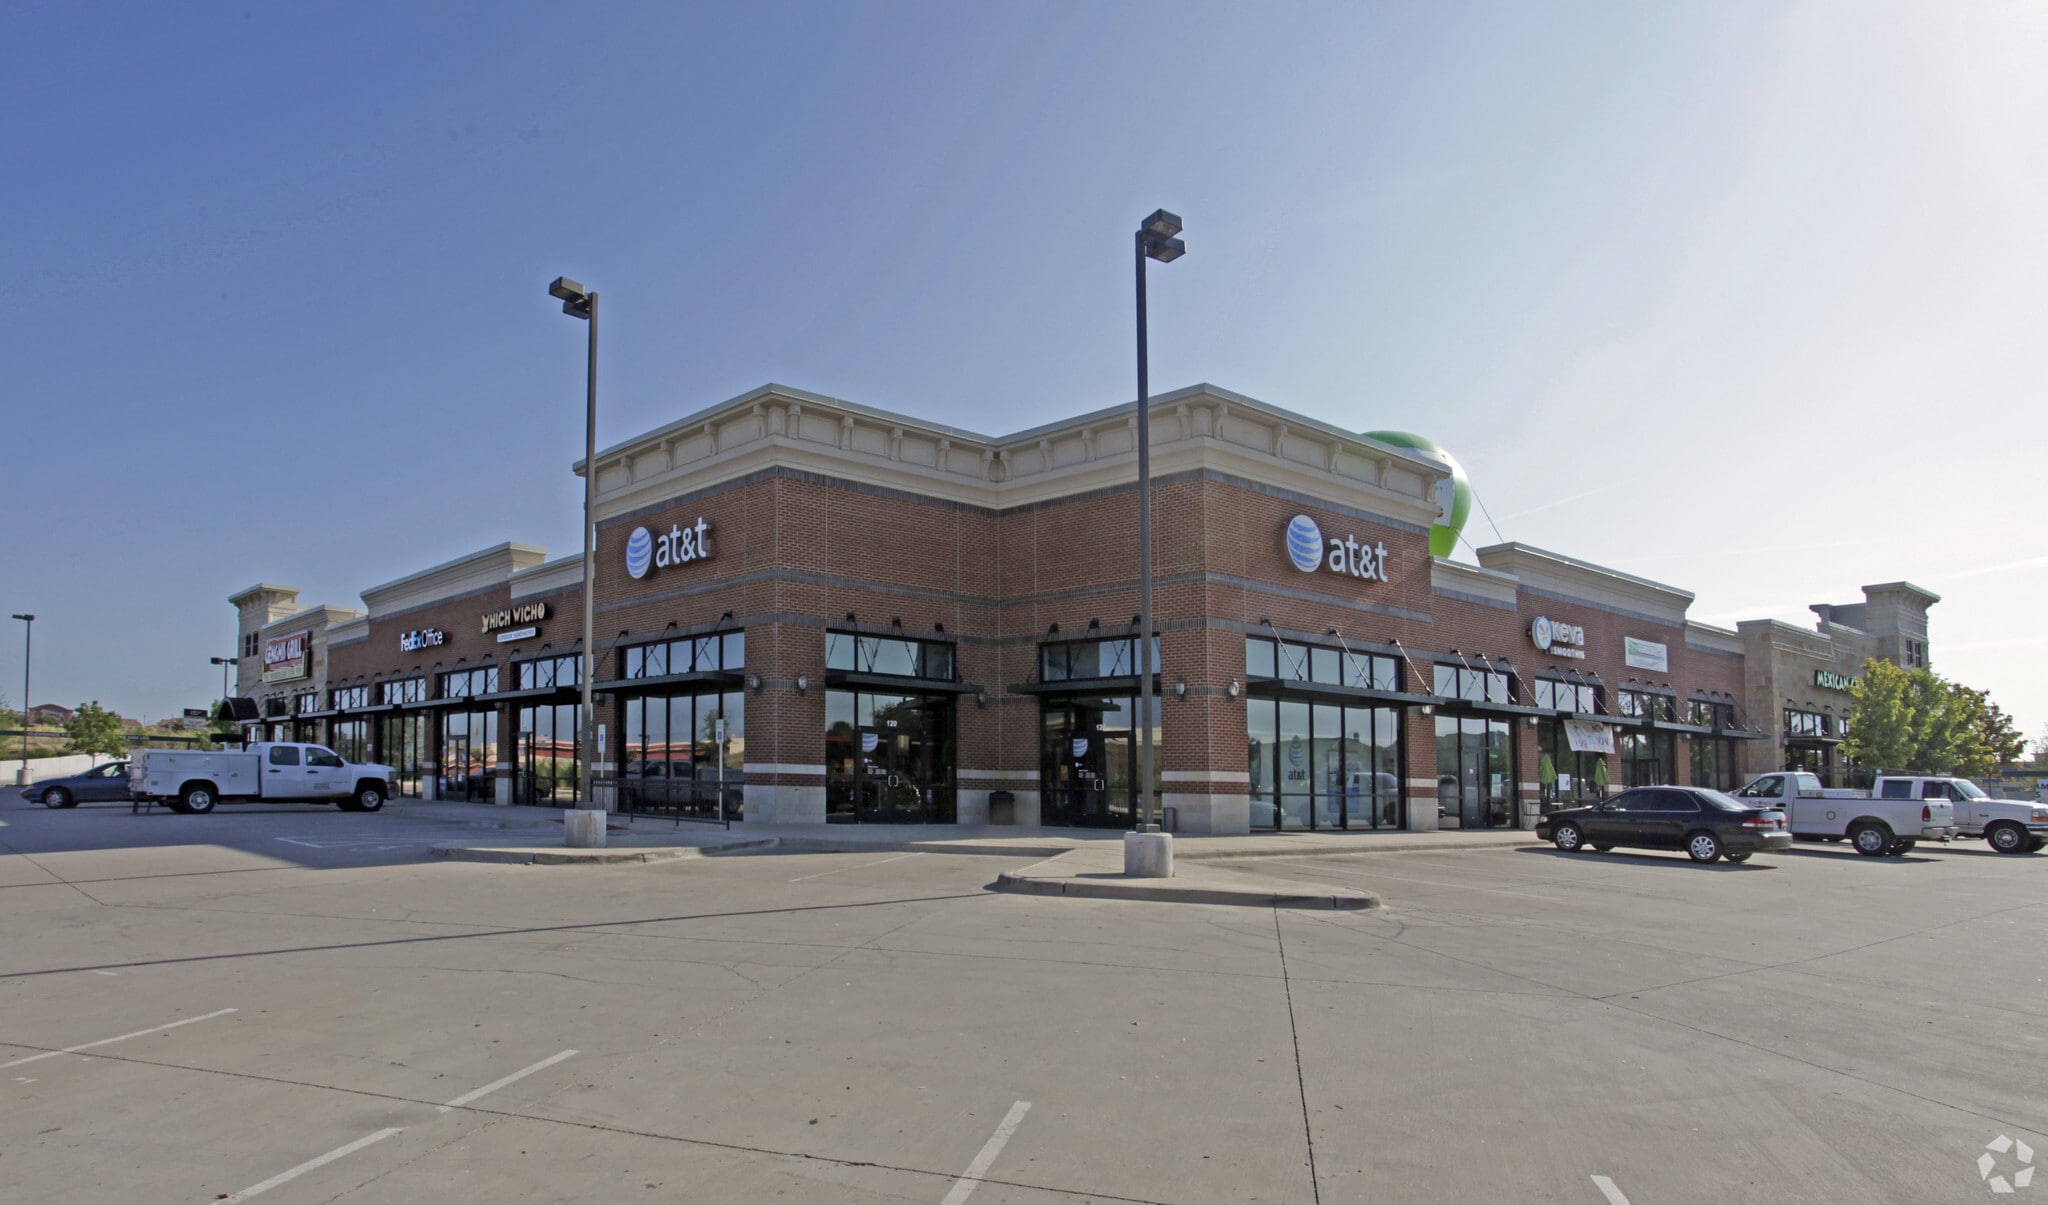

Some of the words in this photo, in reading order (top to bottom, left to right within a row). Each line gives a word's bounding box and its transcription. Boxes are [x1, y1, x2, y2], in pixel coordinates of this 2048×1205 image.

[656, 516, 707, 567] at&t
[1328, 533, 1388, 582] at&t
[400, 630, 421, 652] FedEx
[422, 628, 443, 648] Office
[1817, 670, 1849, 690] MEXICAN
[1288, 769, 1305, 780] at&t
